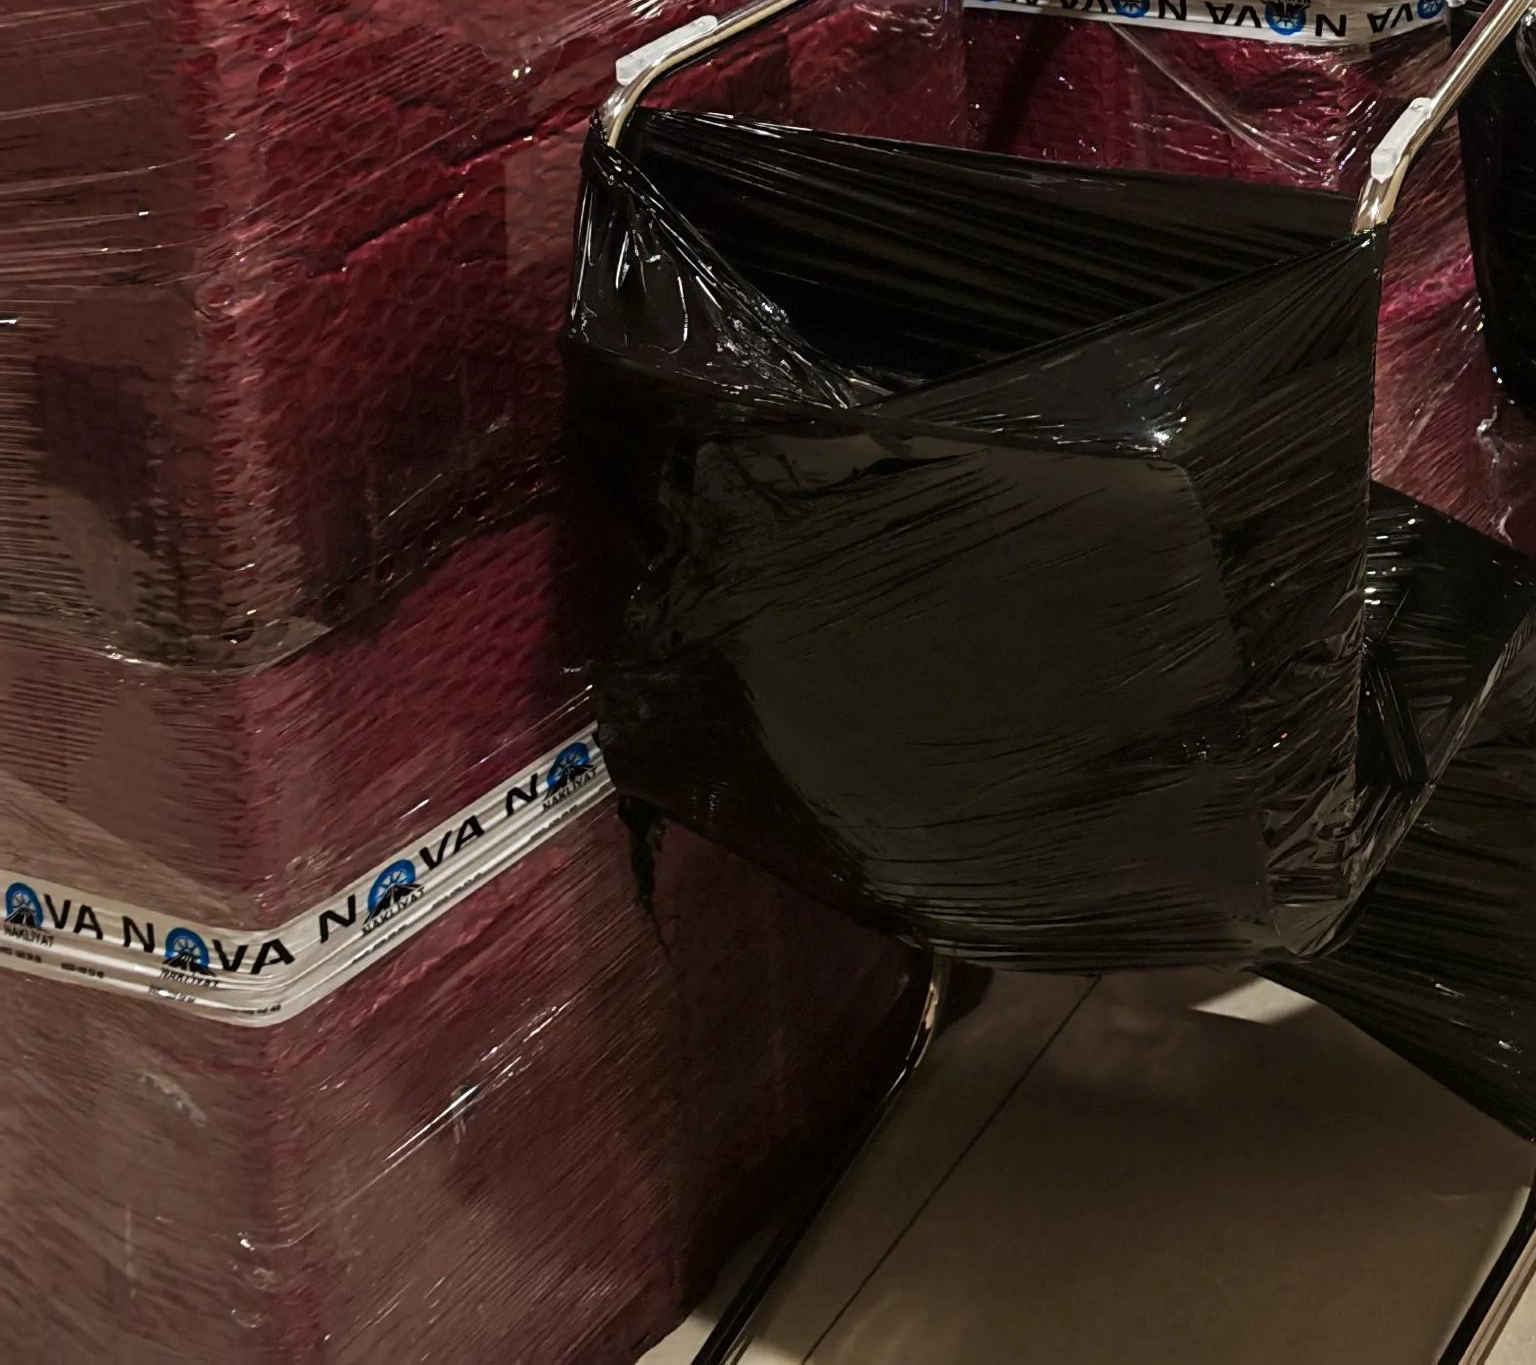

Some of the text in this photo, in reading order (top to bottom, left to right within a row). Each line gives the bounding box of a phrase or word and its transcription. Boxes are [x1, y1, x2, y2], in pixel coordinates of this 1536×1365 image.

[1205, 0, 1347, 37] NOVA
[3, 882, 104, 940] OVA
[121, 915, 296, 977] NOVA
[318, 815, 485, 944] NOVA
[506, 737, 597, 817] NO
